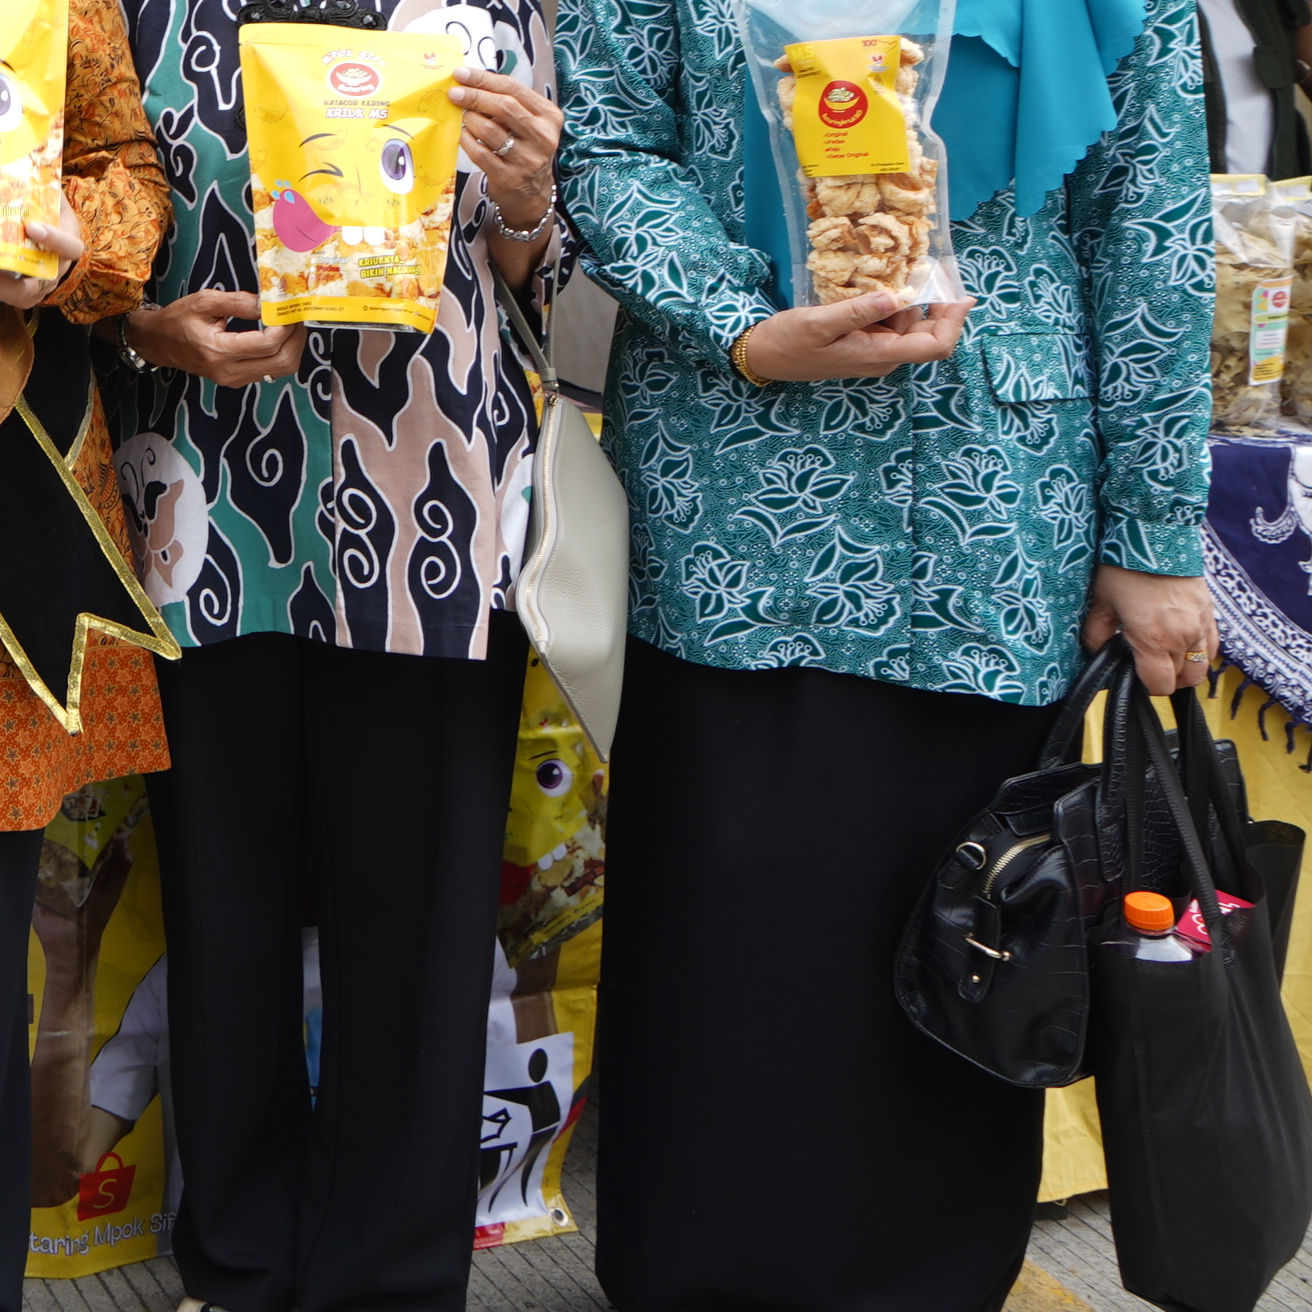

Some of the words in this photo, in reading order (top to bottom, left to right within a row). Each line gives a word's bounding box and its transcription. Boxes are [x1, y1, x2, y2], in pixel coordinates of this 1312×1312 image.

[325, 107, 365, 119] KRIUK
[368, 108, 389, 120] MS
[29, 1230, 90, 1256] taring
[94, 1217, 144, 1247] Mpok
[149, 1212, 176, 1234] Sif
